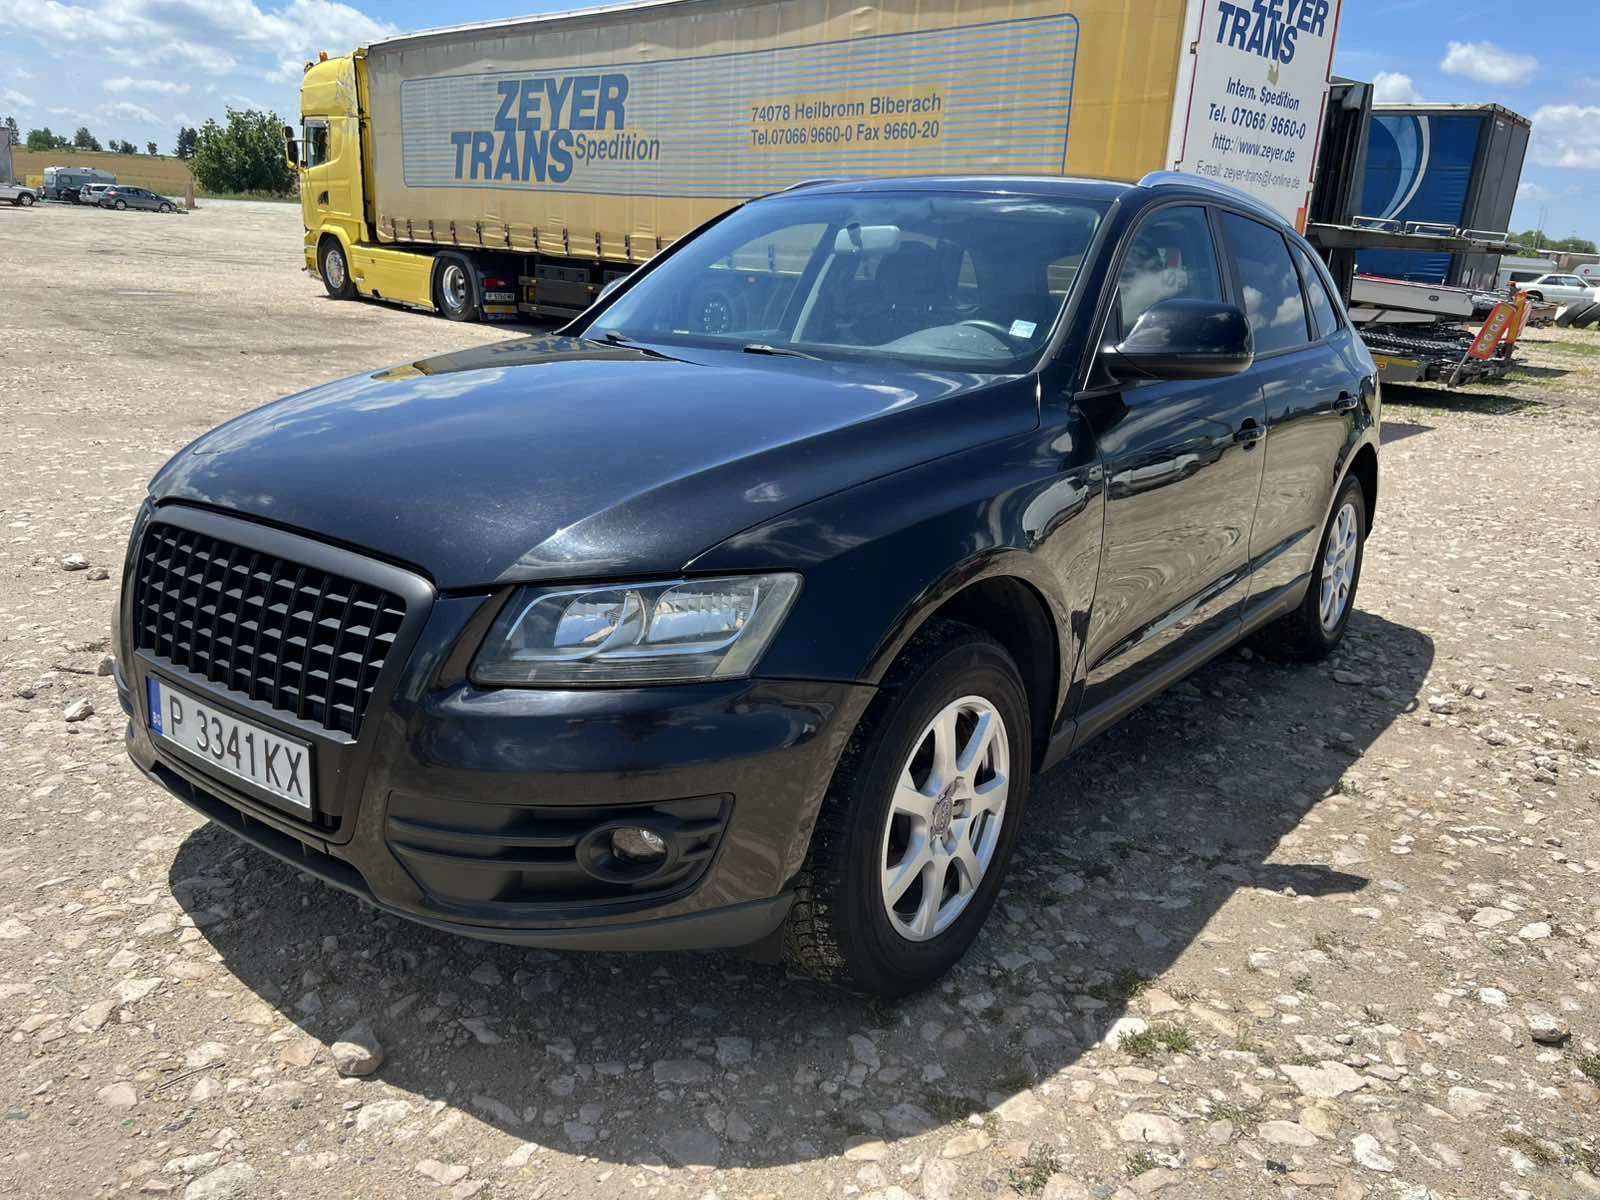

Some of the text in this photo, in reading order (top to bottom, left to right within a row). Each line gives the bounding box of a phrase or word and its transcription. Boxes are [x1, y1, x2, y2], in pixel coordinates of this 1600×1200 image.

[1216, 1, 1298, 64] TRANS
[494, 74, 629, 131] ZEYER
[751, 92, 942, 122] 74078 Heilbronn Biberach
[1226, 77, 1299, 111] Intern. Spedition
[856, 123, 880, 141] Fax
[884, 120, 940, 140] 9660-20
[1209, 103, 1227, 123] Tel.
[451, 129, 660, 183] TRANS Spedition
[170, 695, 183, 736] P
